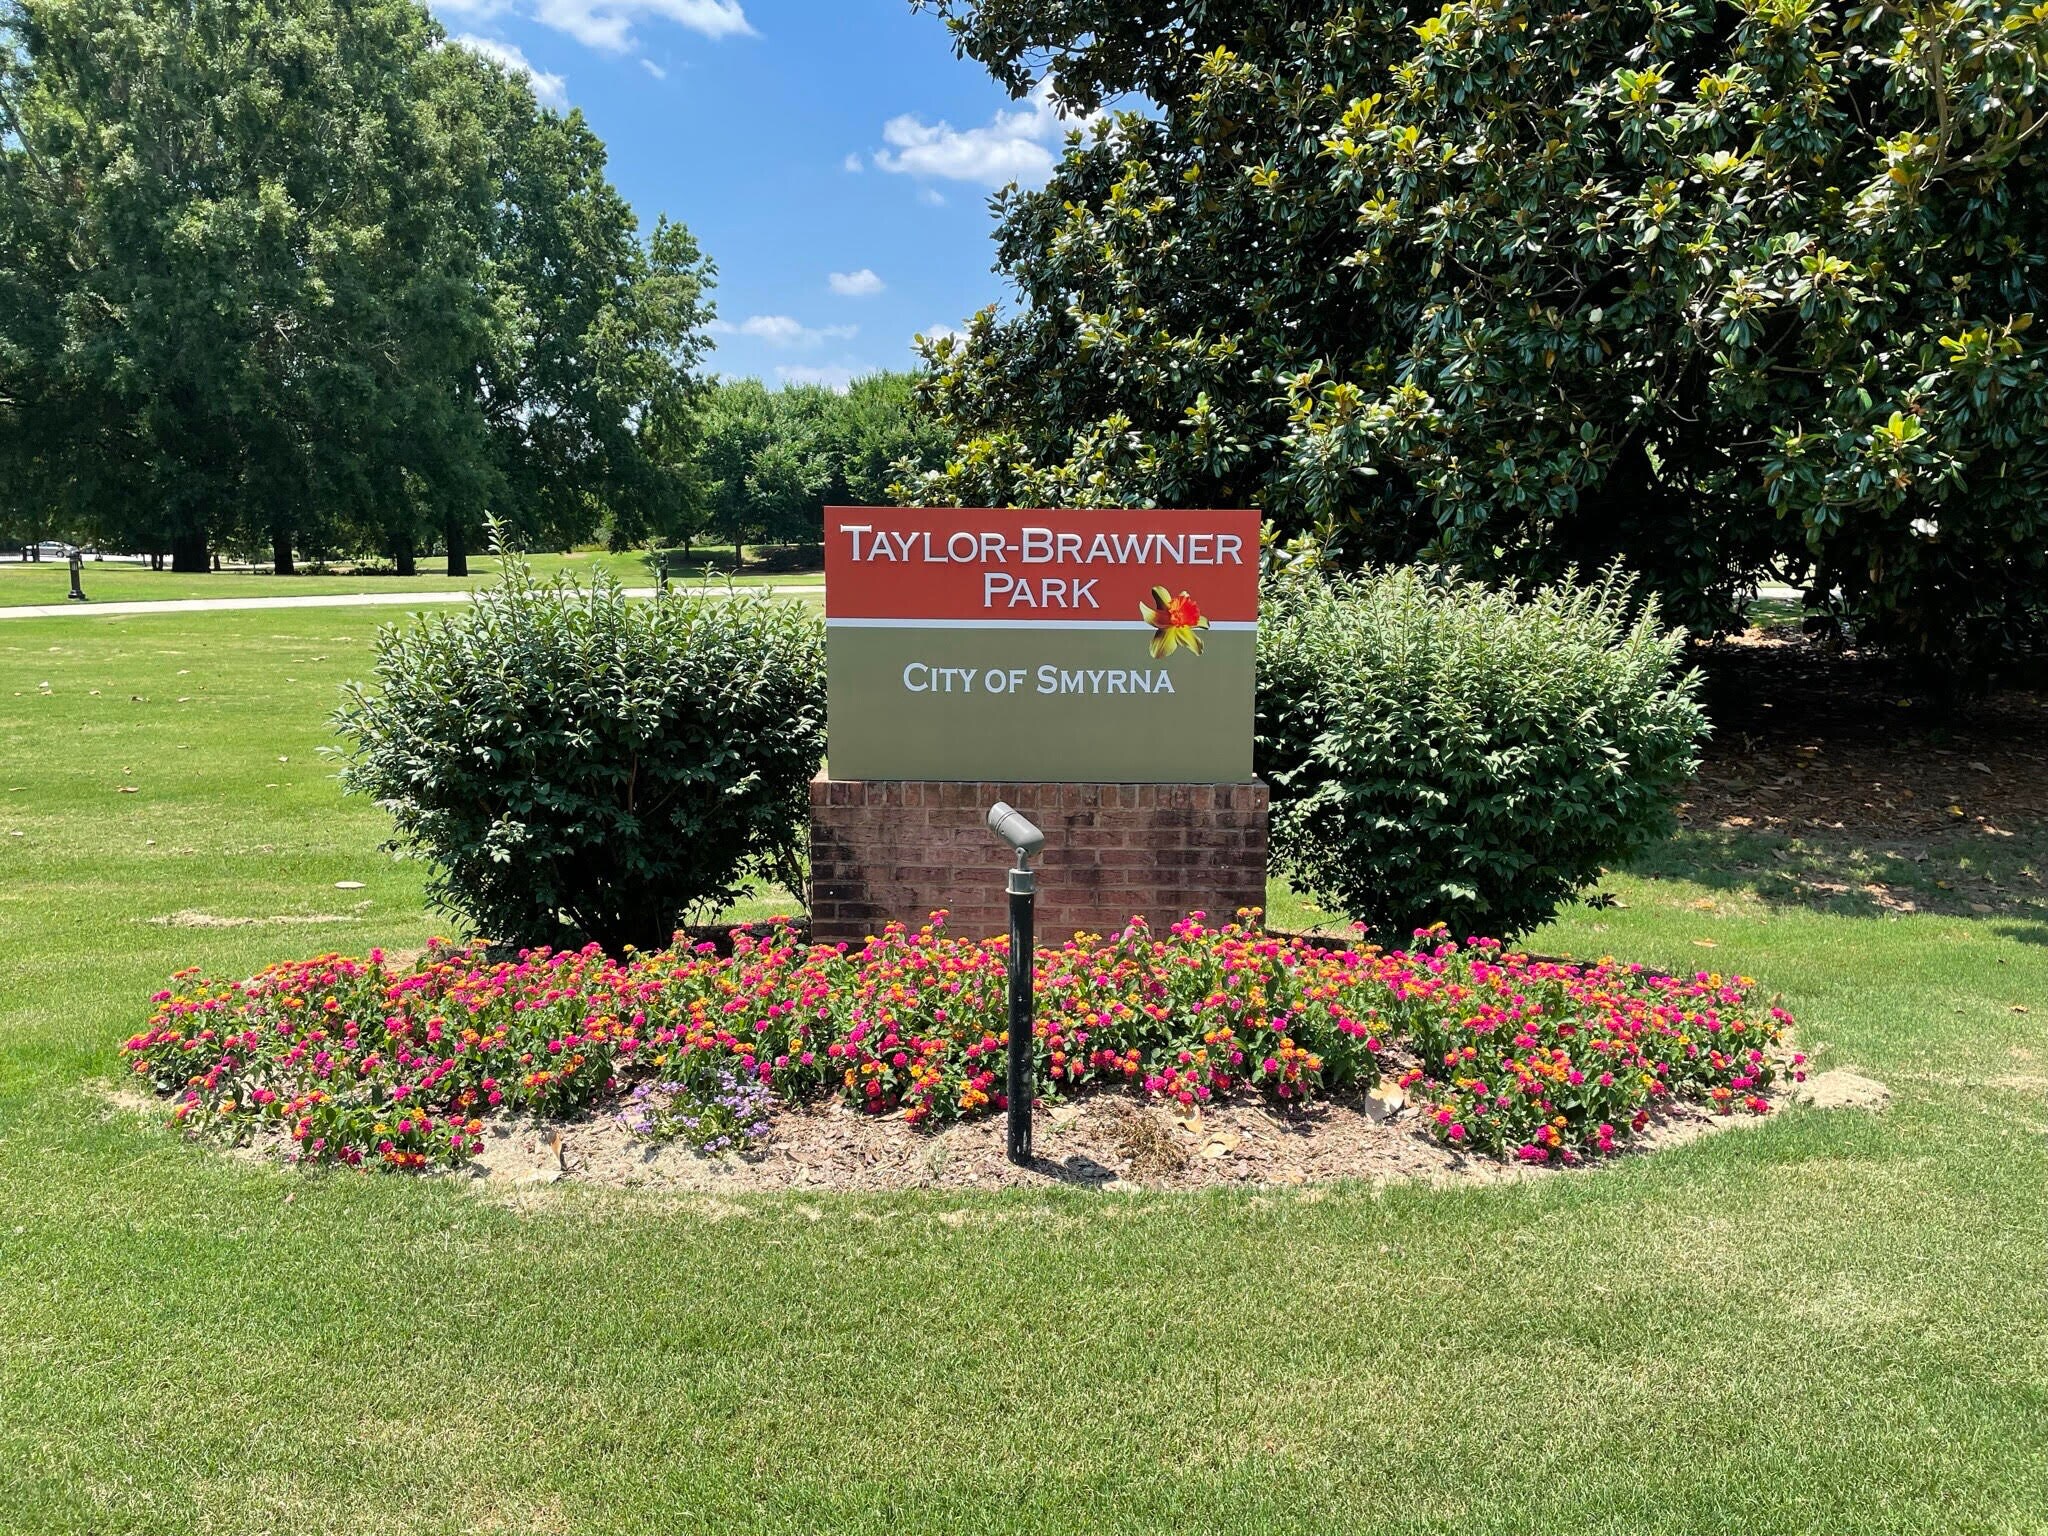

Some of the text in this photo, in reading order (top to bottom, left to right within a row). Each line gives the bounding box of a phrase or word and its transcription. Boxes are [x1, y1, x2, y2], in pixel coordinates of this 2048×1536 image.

[840, 524, 1243, 565] TAYLOR-BRAWNER
[983, 572, 1100, 608] PARK
[903, 662, 1175, 694] CITY OF SMYRNA
